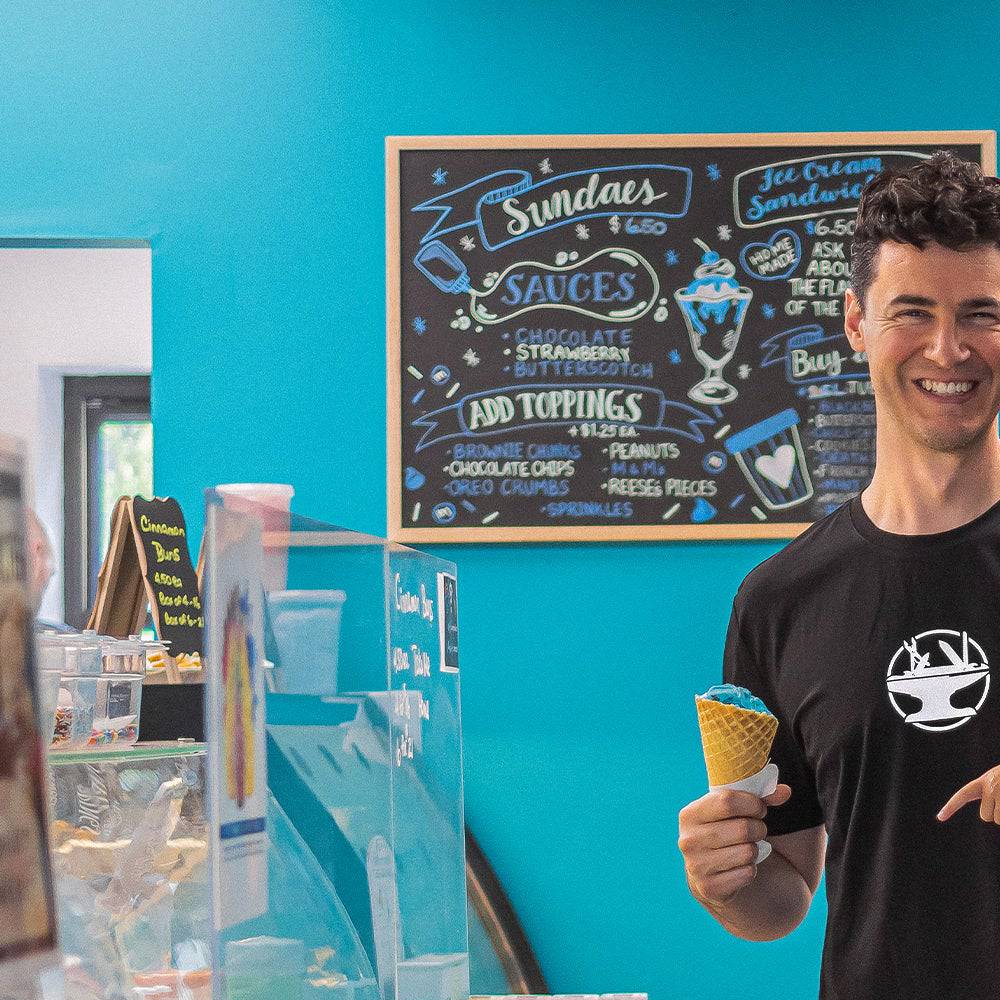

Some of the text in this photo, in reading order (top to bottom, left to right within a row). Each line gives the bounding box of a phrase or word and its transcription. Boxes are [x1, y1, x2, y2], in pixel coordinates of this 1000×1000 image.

[758, 157, 882, 193] Ice Cream
[502, 173, 668, 236] Sundaes
[746, 173, 875, 221] Sandwic
[811, 241, 845, 258] ASK
[501, 272, 637, 304] SAUCES
[787, 278, 818, 296] THE
[784, 300, 841, 316] OF THE
[514, 328, 633, 345] CHOCOLATE
[515, 344, 630, 362] STRAWBERRY
[514, 361, 654, 378] BUTTERSCOTCH
[470, 388, 642, 430] ADD TOPPINGS
[453, 442, 582, 460] BROWNIE CHUNKS
[609, 442, 680, 460] PEANUTS
[448, 460, 575, 477] CHOCOLATE CHIPS
[446, 479, 570, 497] OREO CRUMBS
[665, 478, 718, 497] PIECES
[547, 501, 634, 518] SPRINKLES
